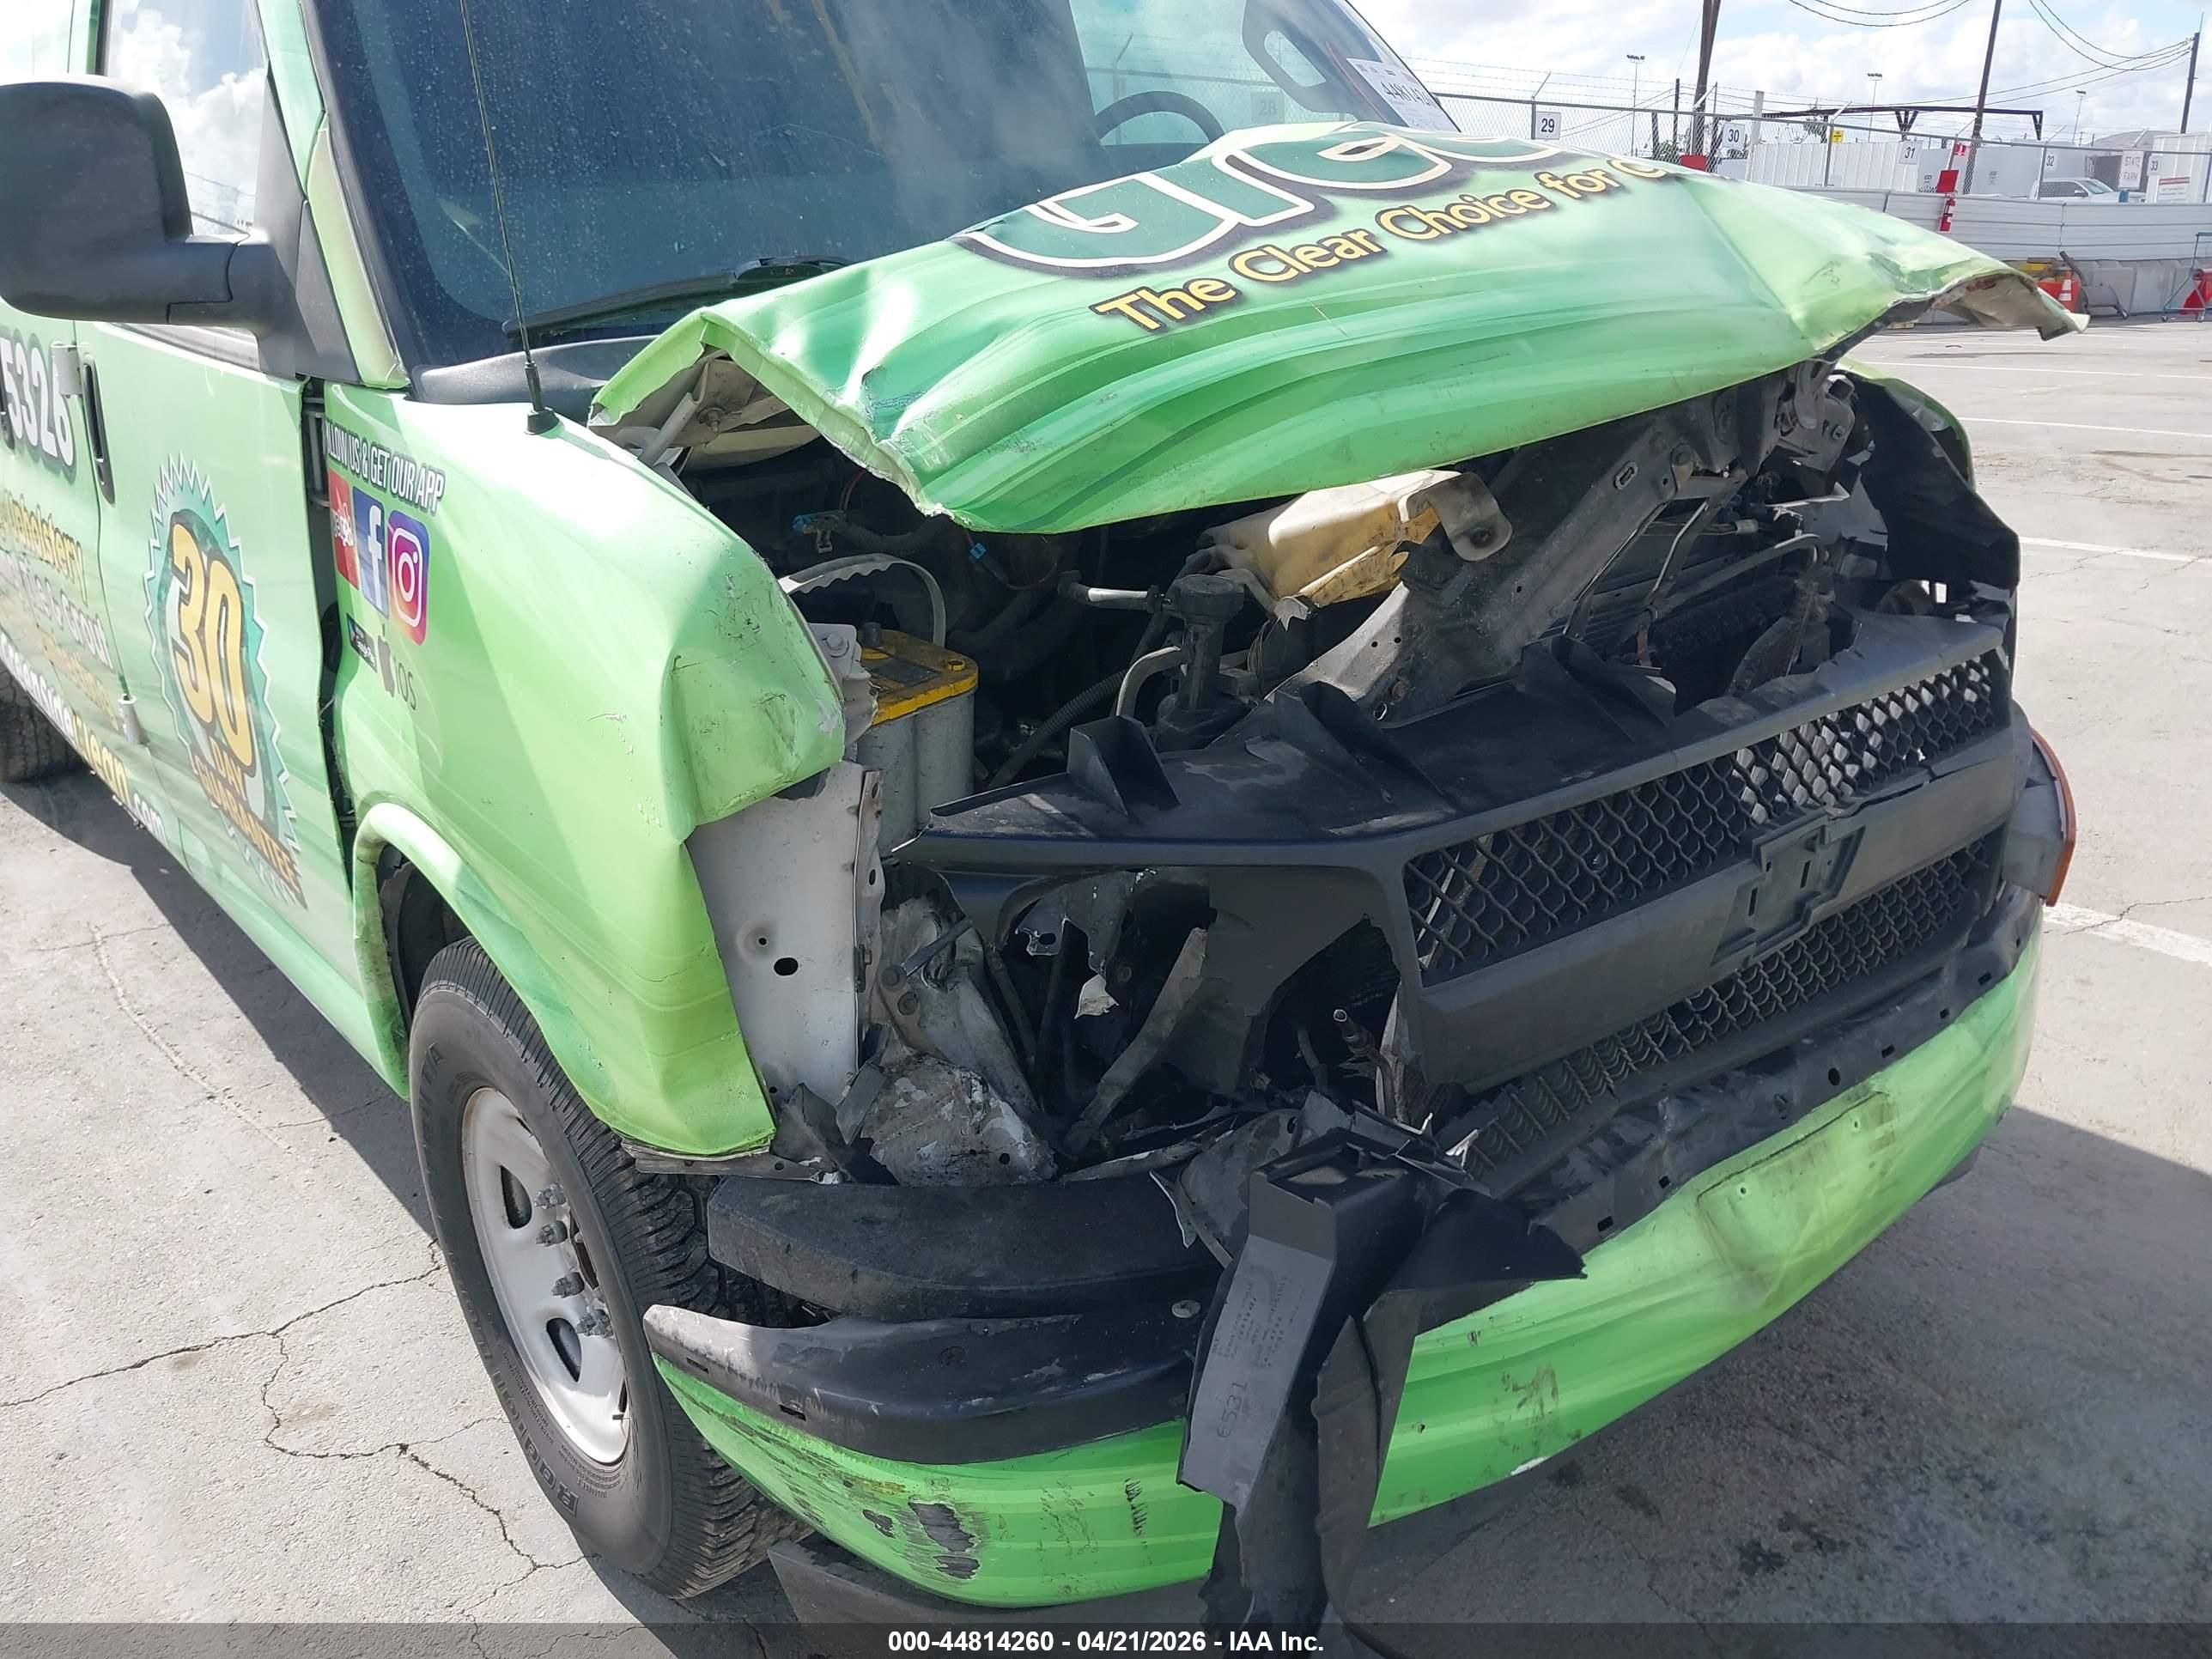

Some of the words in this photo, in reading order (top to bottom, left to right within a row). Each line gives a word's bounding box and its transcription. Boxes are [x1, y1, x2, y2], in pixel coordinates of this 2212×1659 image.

[1540, 118, 1555, 133] 29
[1728, 129, 1740, 143] 30
[1905, 146, 1916, 159] 31
[2046, 155, 2055, 167] 32
[2124, 156, 2141, 167] STATE
[2151, 161, 2159, 171] 33
[2124, 172, 2138, 180] FARM
[1093, 277, 1237, 331] The
[1231, 228, 1382, 283] Clear
[1378, 190, 1553, 241] Choice
[1537, 169, 1622, 199] for
[0, 337, 74, 466] 5326
[348, 433, 360, 474] US
[362, 441, 369, 479] &
[370, 445, 391, 489] GET
[391, 455, 416, 501] OUR
[415, 466, 445, 513] APP
[173, 523, 254, 768] 30
[393, 655, 416, 711] iOS
[194, 754, 301, 891] GUARANTEE
